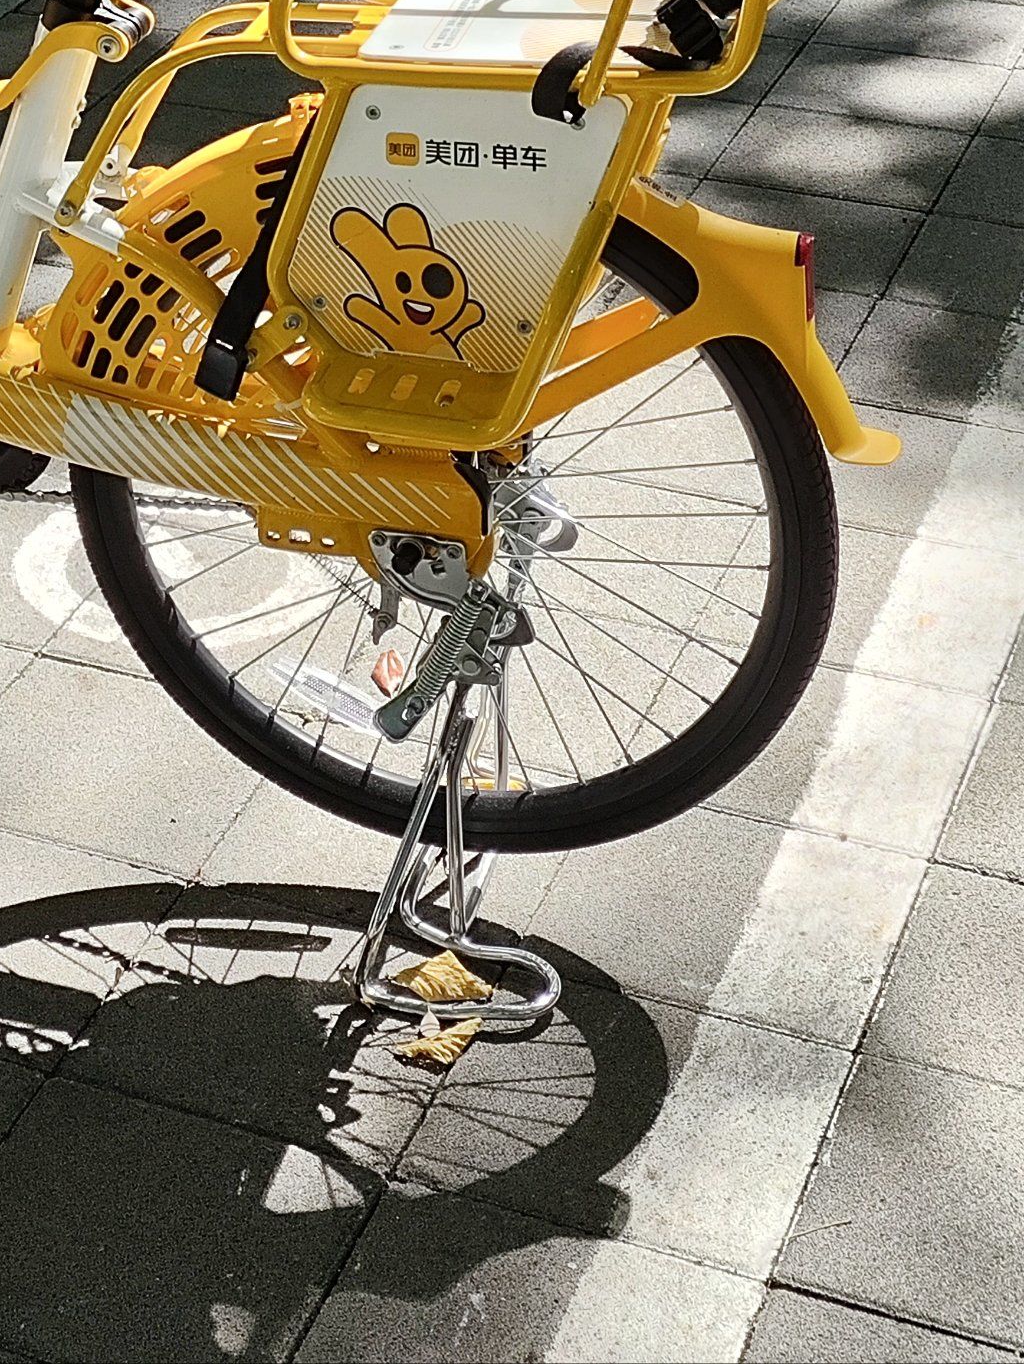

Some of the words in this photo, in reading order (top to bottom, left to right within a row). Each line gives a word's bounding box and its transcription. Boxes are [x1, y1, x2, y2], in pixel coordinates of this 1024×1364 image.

[388, 141, 417, 158] 美团
[425, 139, 548, 172] 美团·单车
